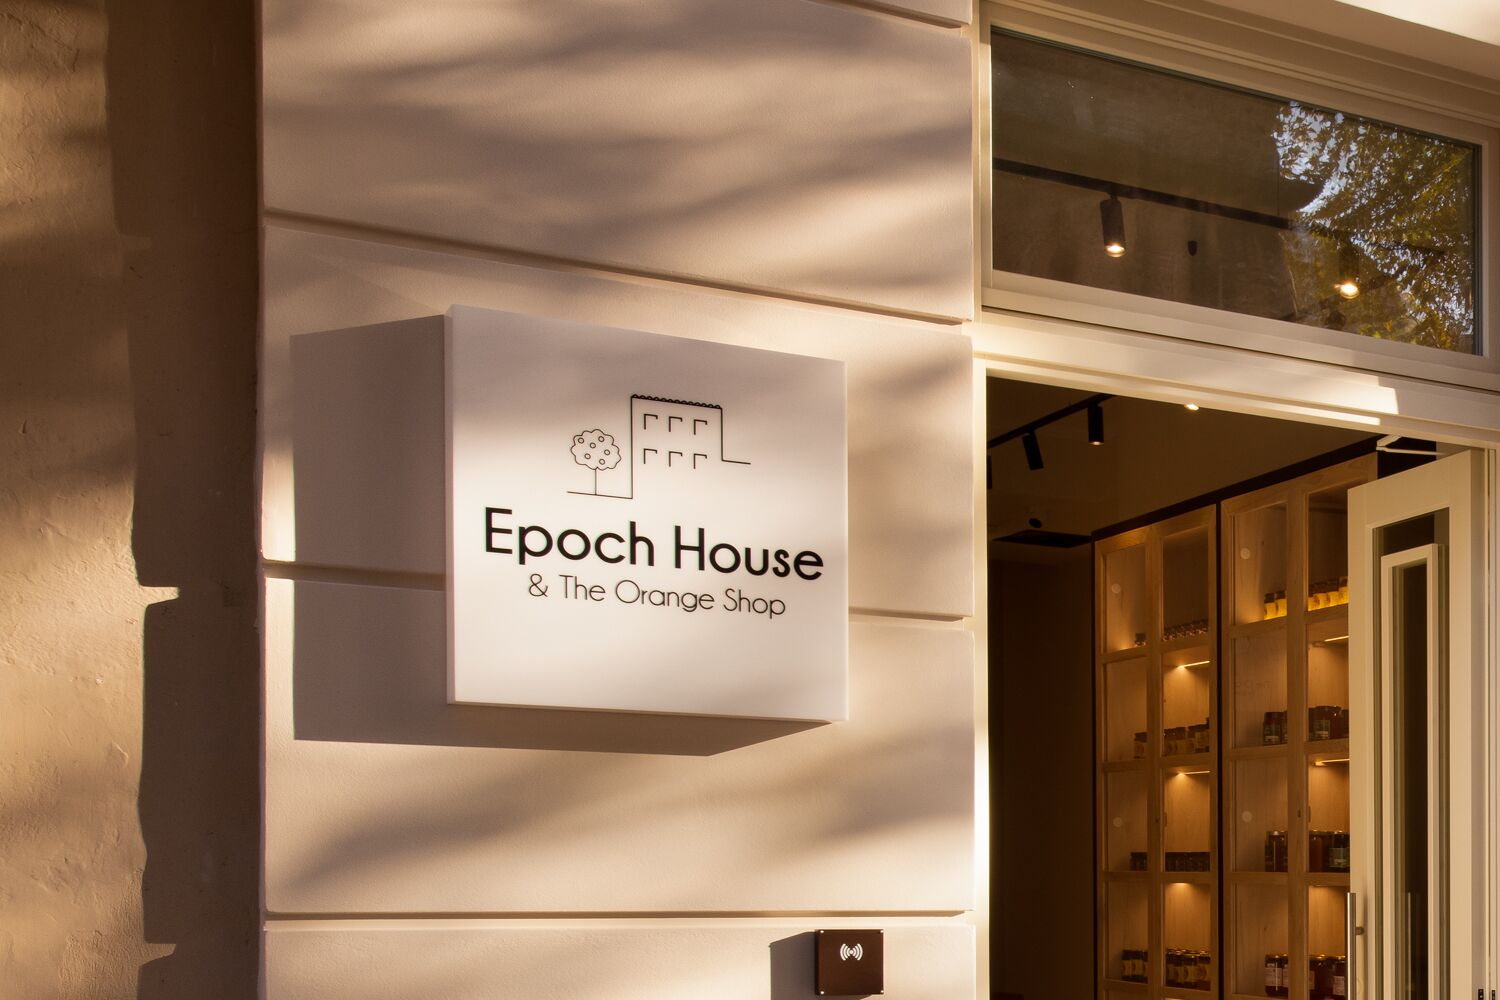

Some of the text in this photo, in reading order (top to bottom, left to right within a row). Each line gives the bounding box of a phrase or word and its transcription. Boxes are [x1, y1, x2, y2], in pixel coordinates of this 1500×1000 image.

[484, 506, 824, 581] Epoch House
[528, 573, 786, 620] & The Orange Shop
